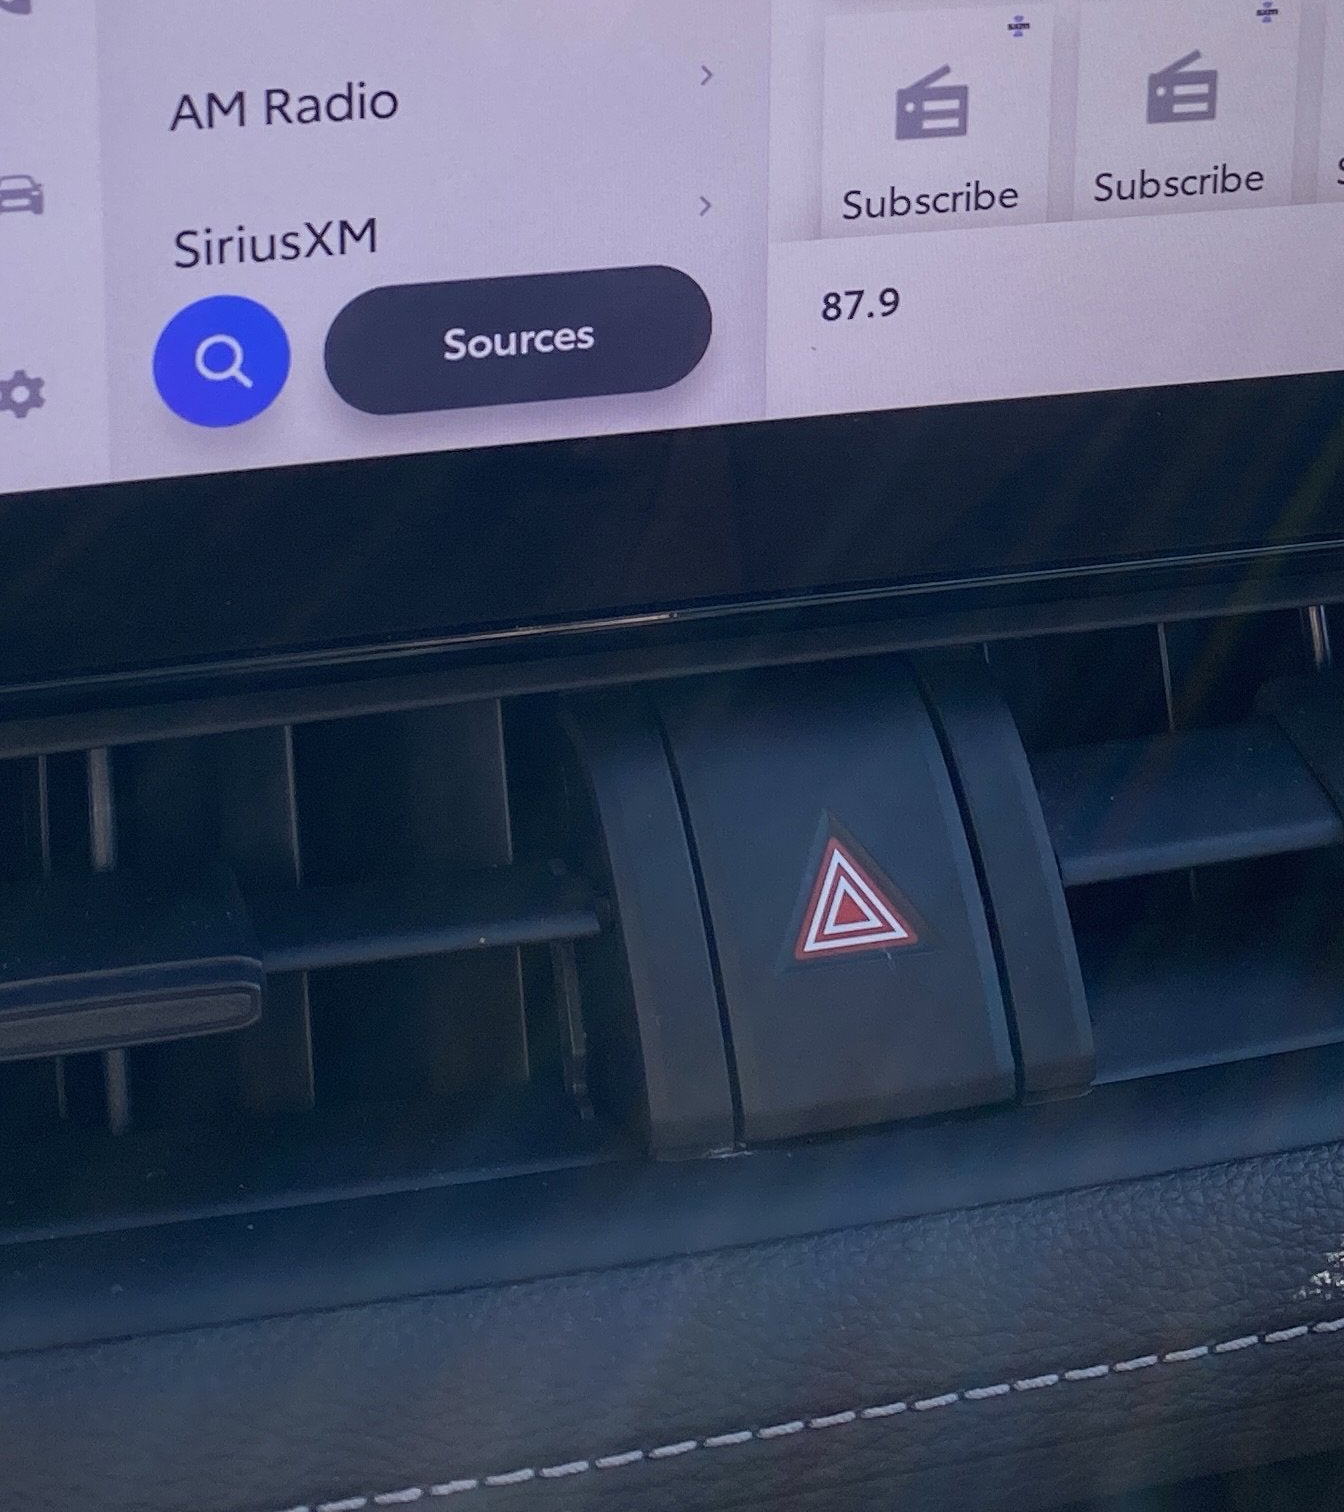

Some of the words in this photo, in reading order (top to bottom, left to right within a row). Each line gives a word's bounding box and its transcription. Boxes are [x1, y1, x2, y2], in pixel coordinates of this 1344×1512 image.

[170, 90, 246, 131] AM
[264, 80, 400, 126] Radio
[842, 180, 1020, 221] Subscribe
[1094, 163, 1265, 203] Subscribe
[174, 217, 378, 270] SiriusXM
[820, 287, 901, 323] 87.9
[443, 325, 596, 362] Sources
